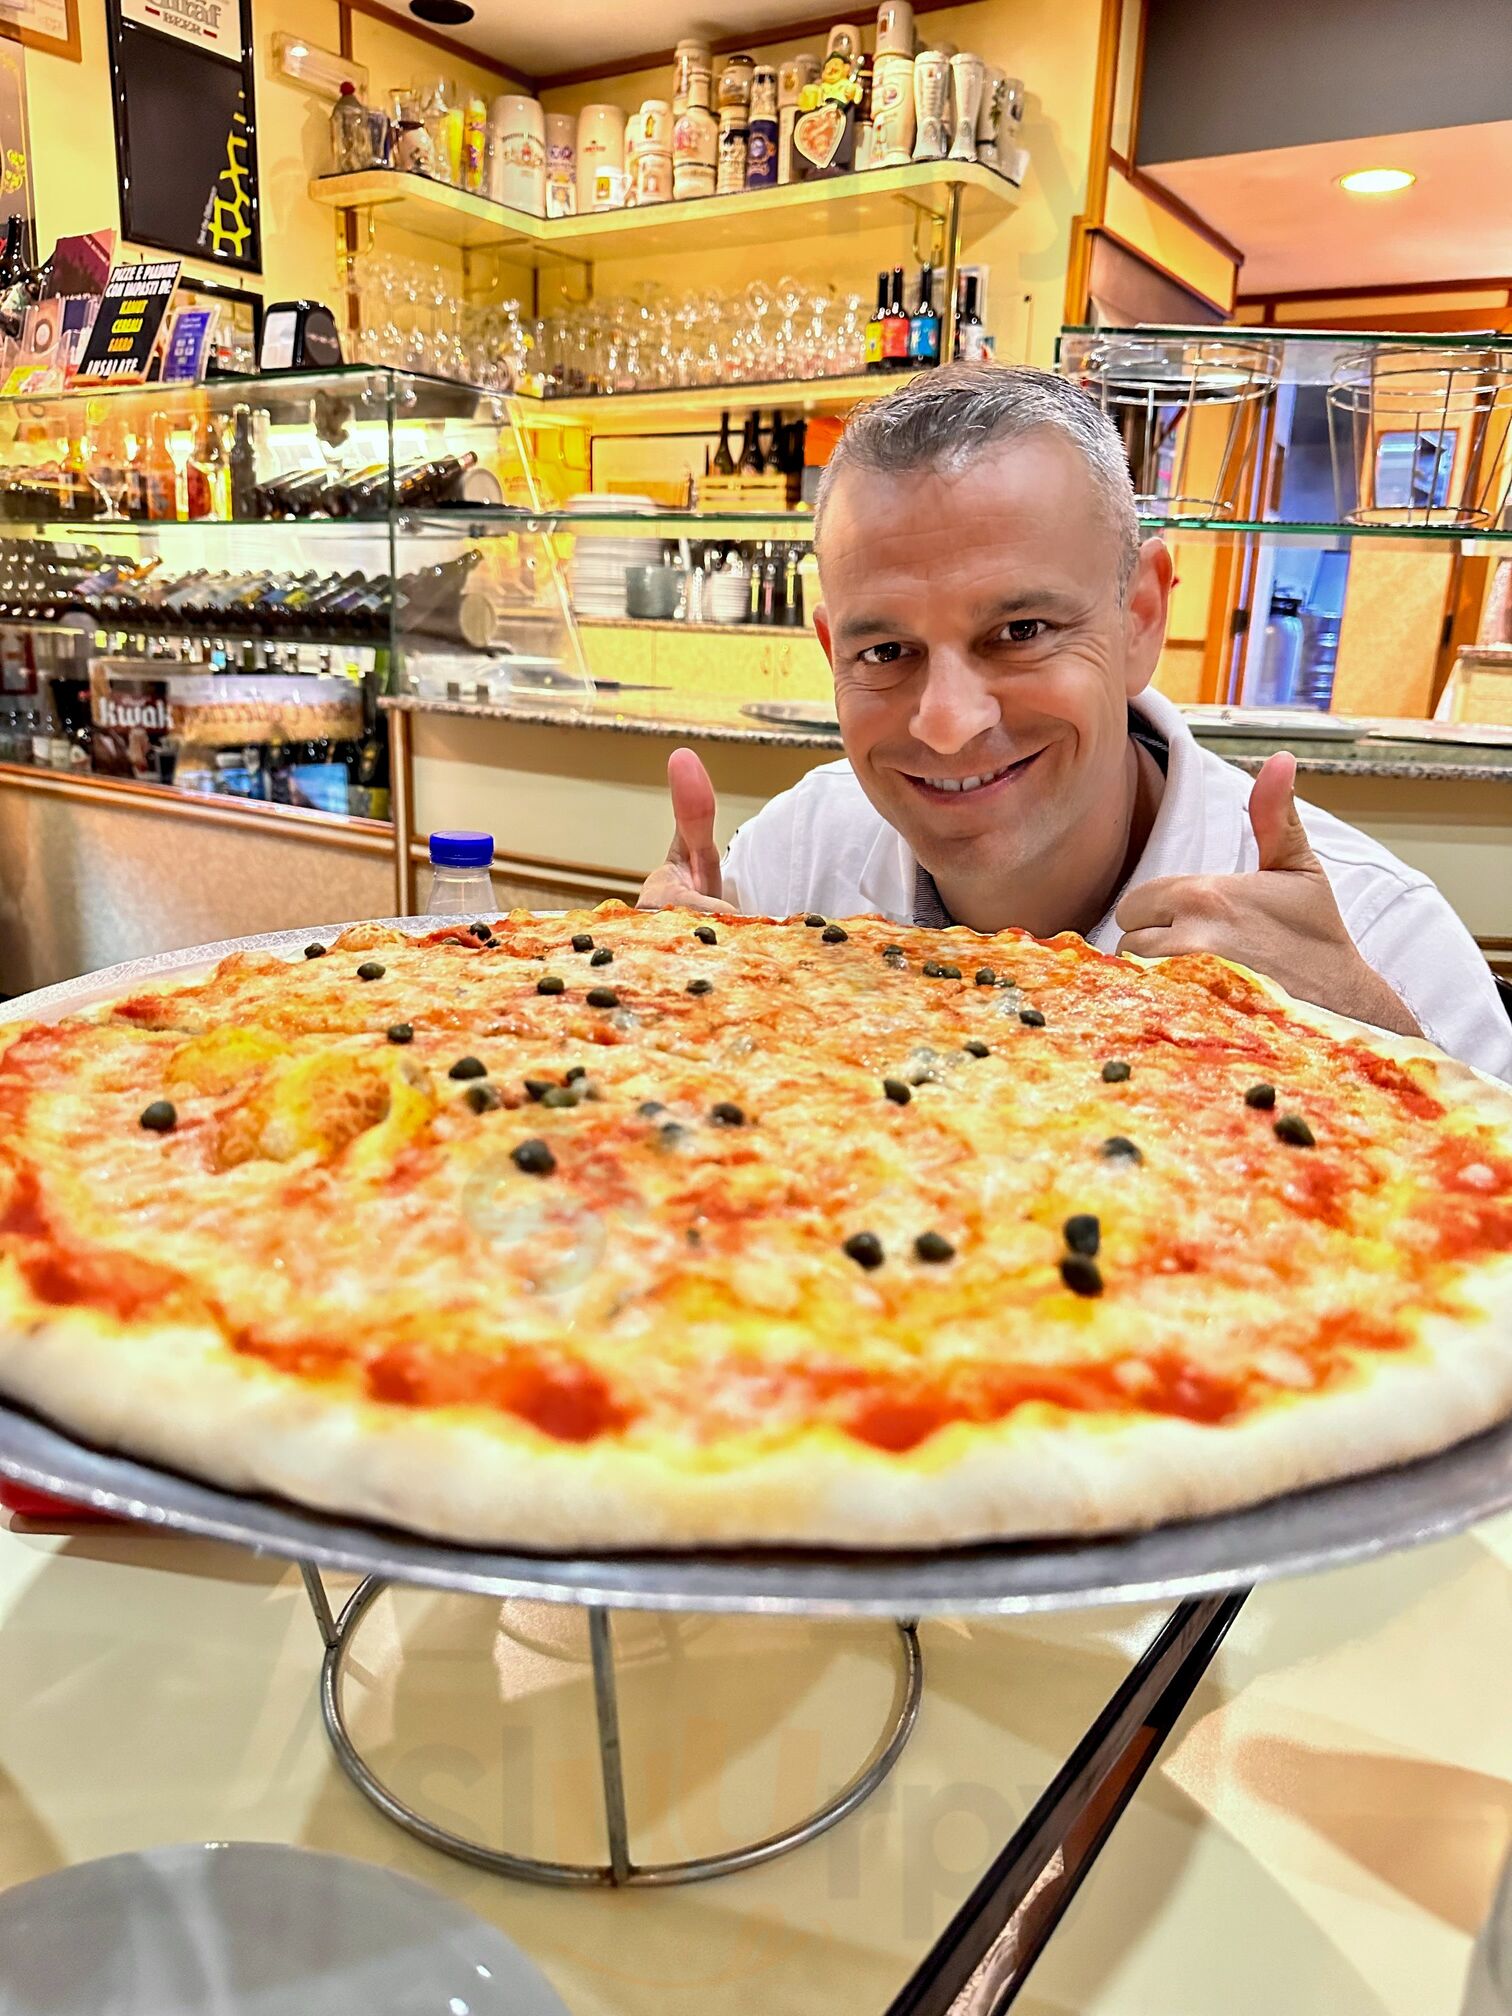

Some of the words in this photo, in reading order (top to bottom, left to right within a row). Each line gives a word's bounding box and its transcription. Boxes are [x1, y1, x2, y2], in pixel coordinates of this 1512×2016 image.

[163, 11, 202, 36] BEER
[111, 267, 137, 282] PIZZE
[135, 265, 144, 280] E
[143, 263, 179, 280] PIADINE
[105, 282, 125, 297] CON
[123, 280, 160, 296] IMPASTI
